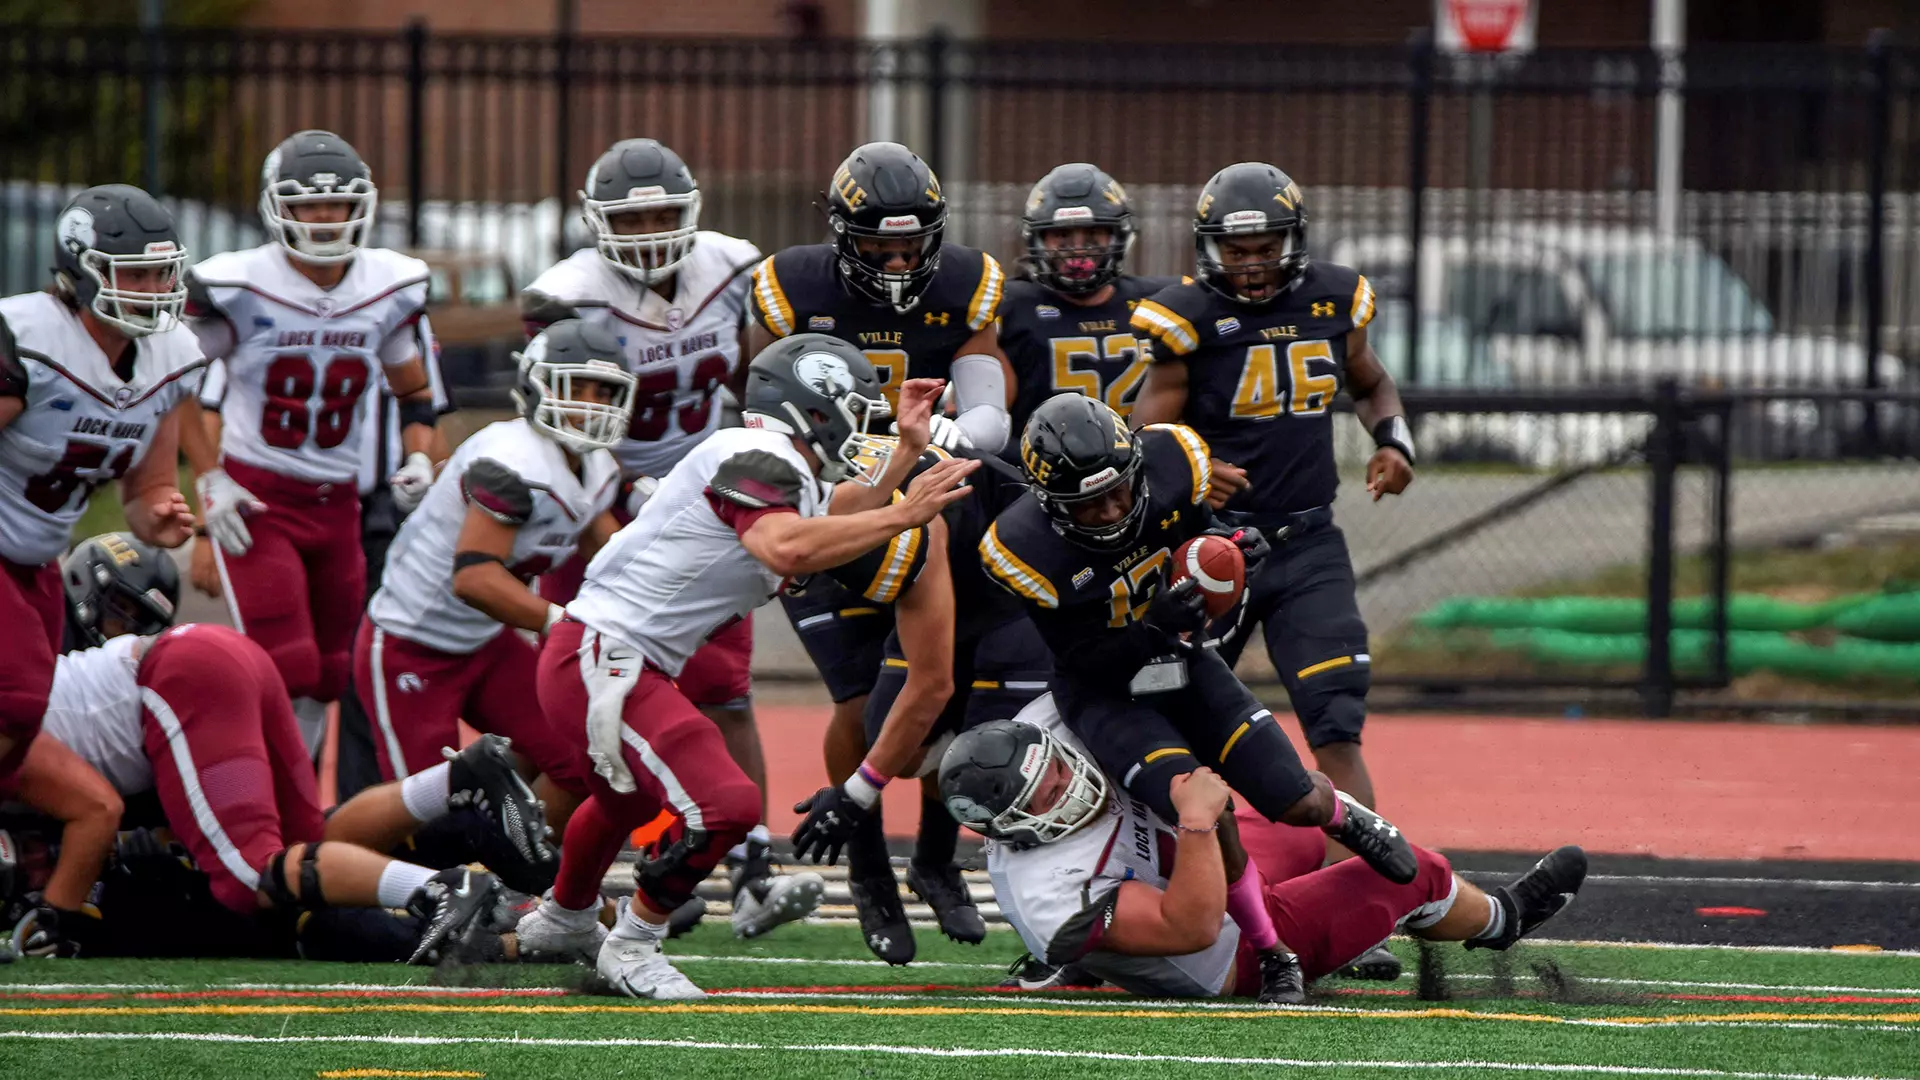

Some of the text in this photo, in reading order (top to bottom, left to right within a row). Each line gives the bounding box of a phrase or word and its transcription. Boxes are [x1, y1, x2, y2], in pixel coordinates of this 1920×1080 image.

[1078, 320, 1117, 332] VILLE
[1259, 325, 1299, 340] VILLE
[277, 330, 367, 347] LOCK HAVEN
[857, 331, 904, 345] VILLE
[639, 341, 675, 365] LOCK
[1048, 333, 1148, 417] 52
[1229, 339, 1337, 420] 46
[260, 353, 371, 450] 88
[72, 416, 148, 439] LOCK HAVEN
[1084, 471, 1114, 488] Riddell
[1112, 545, 1150, 574] VILLE
[1134, 821, 1151, 862] LOCK
